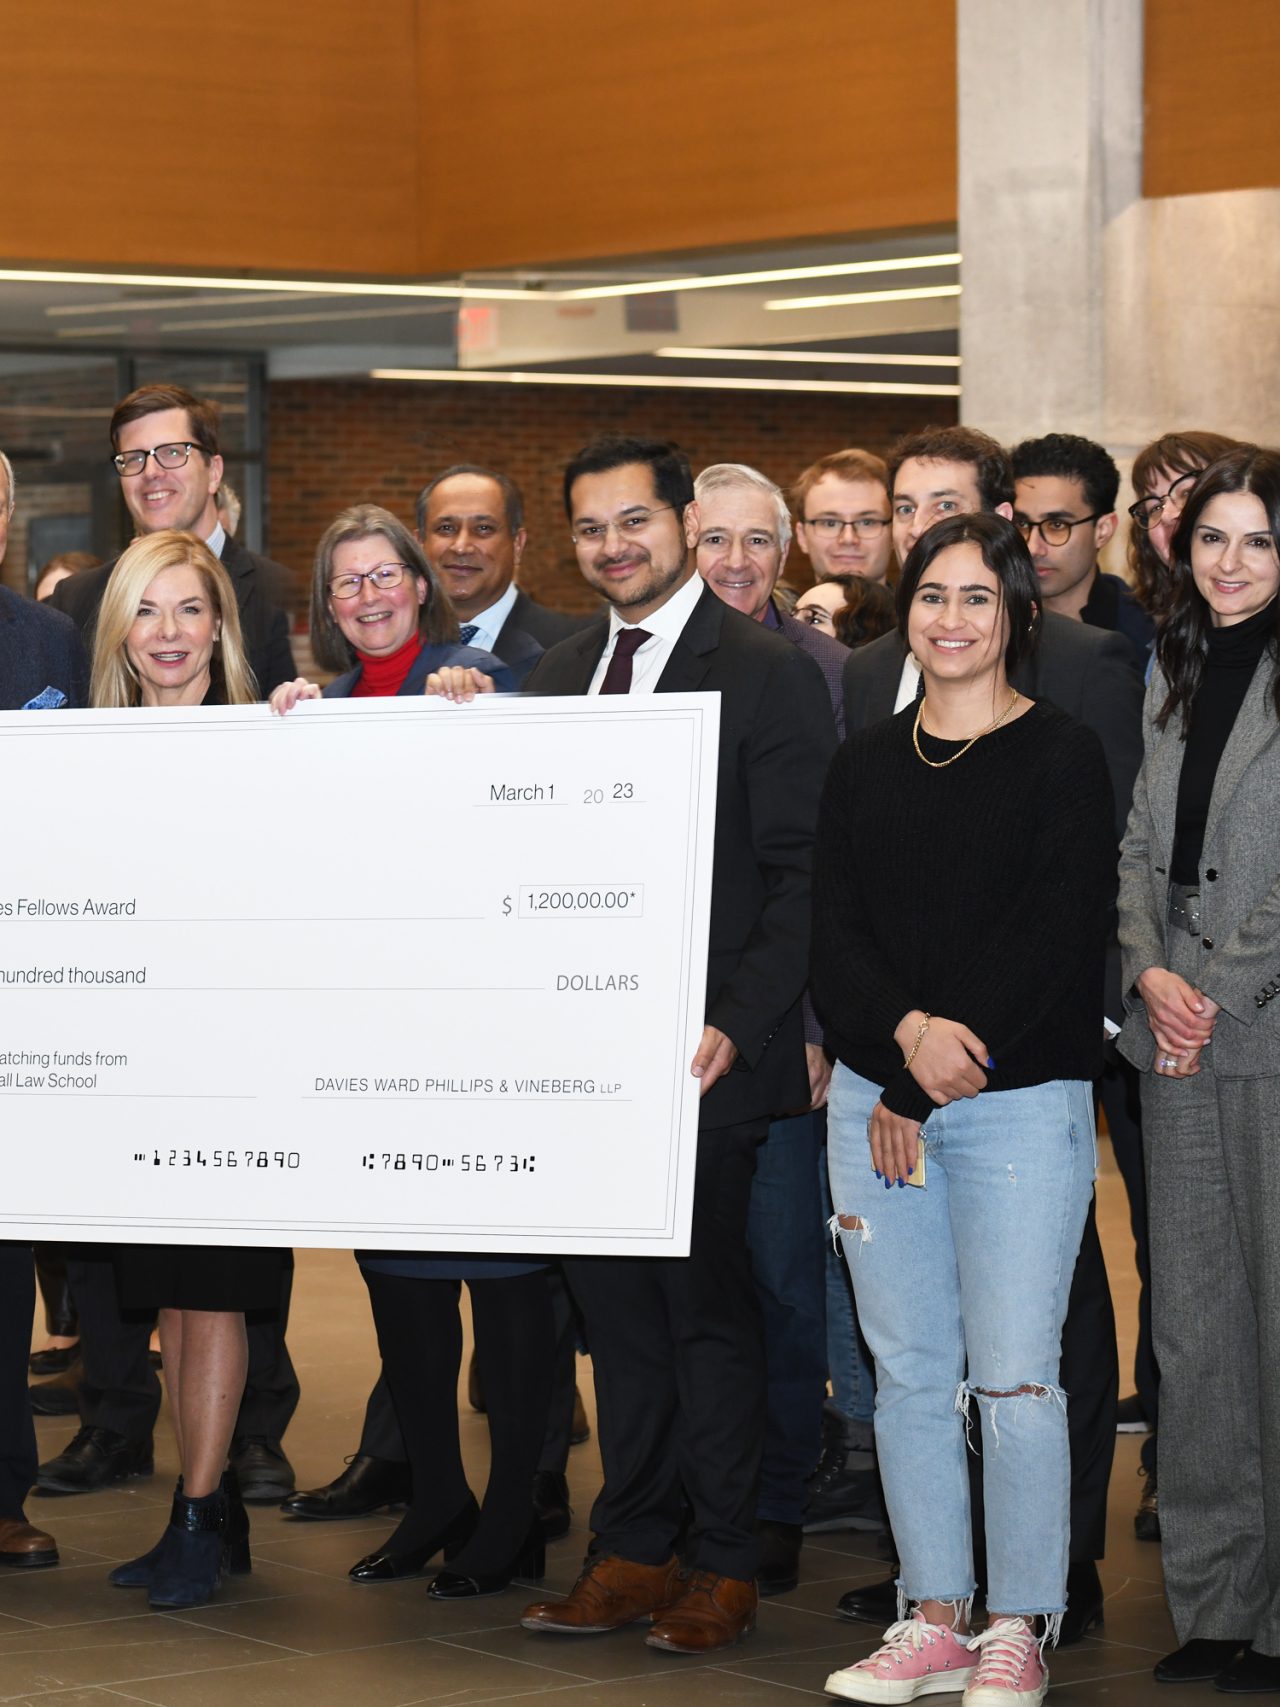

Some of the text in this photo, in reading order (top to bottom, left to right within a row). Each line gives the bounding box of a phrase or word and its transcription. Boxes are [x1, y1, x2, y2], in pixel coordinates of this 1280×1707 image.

[490, 782, 634, 804] March 1 20 23
[17, 898, 80, 917] Fellows
[82, 897, 137, 917] Award
[502, 894, 513, 918] $
[67, 966, 147, 985] thousand
[556, 974, 639, 992] DOLLARS
[52, 1050, 94, 1067] funds
[95, 1050, 128, 1067] from
[15, 1072, 46, 1088] Law
[47, 1072, 98, 1089] School
[314, 1077, 623, 1094] DAVIES WARD PHILLIPS & VINEBERG LLP
